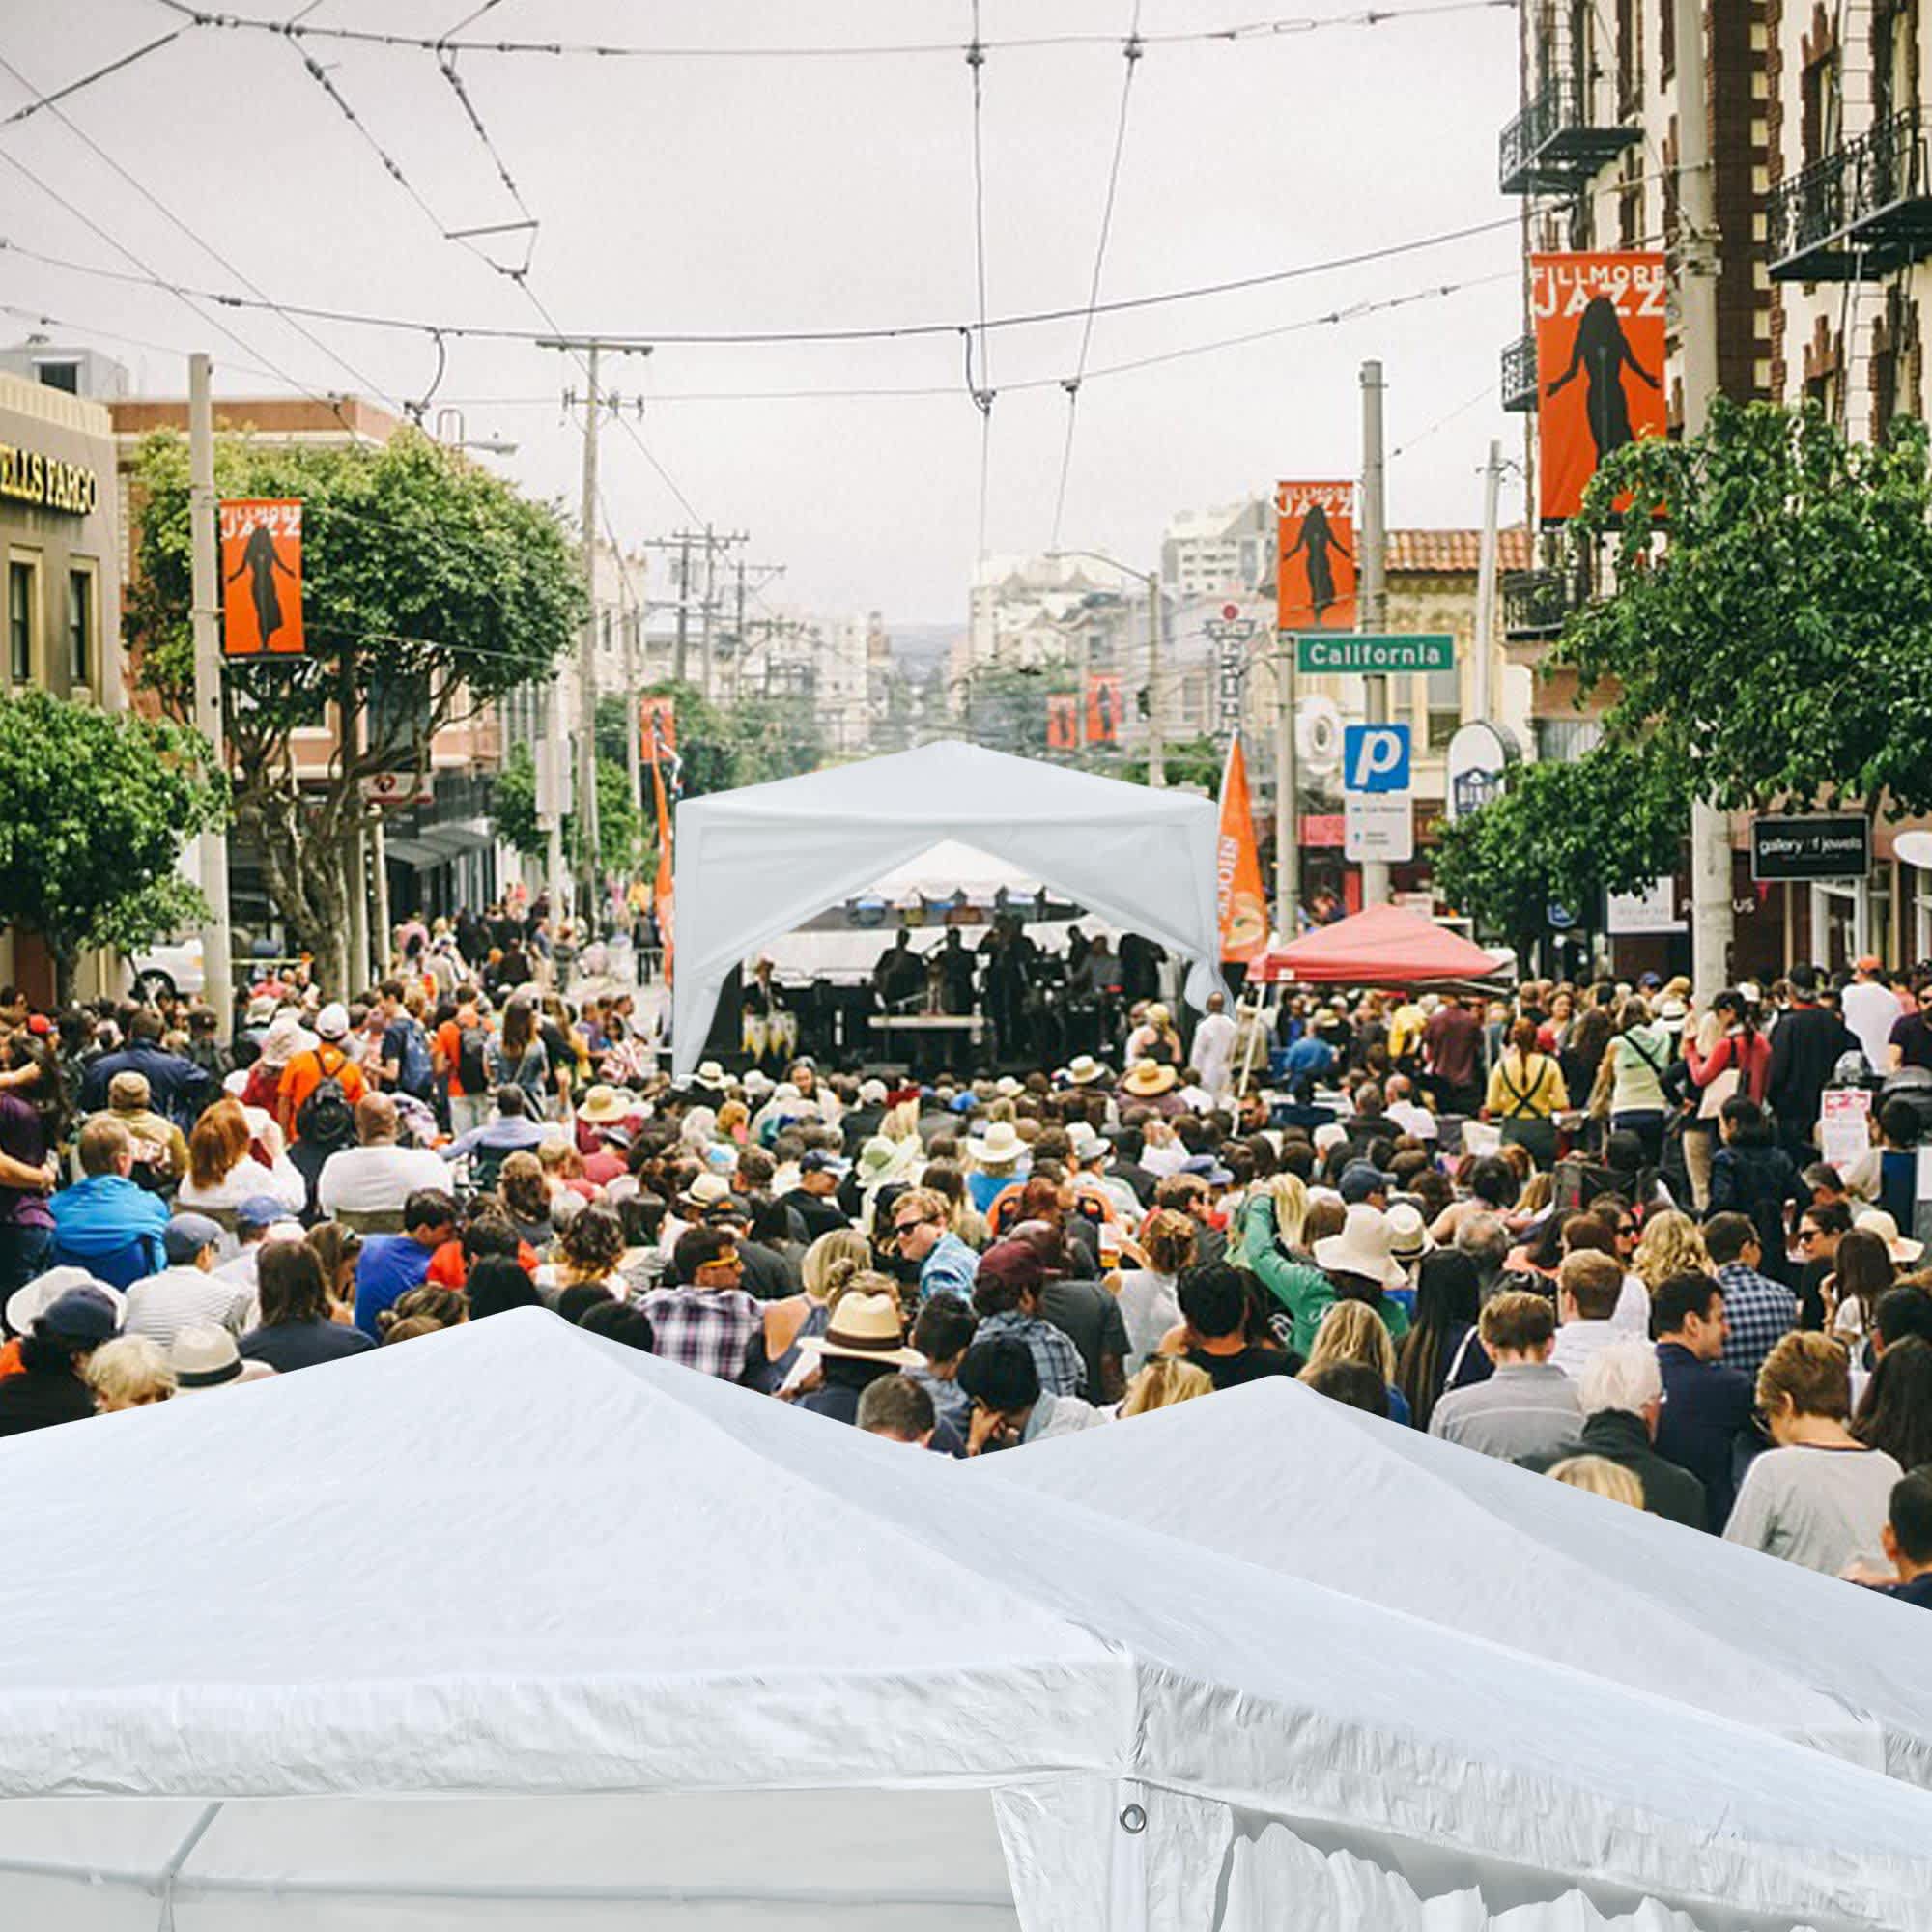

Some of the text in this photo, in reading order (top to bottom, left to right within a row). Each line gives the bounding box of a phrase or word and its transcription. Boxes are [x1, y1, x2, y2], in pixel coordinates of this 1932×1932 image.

[1530, 265, 1665, 285] FILLMORE
[1530, 282, 1666, 317] JAZZ
[0, 441, 99, 514] ELLS FARGO
[221, 515, 302, 538] JAZZ
[1310, 643, 1441, 664] California
[1759, 838, 1803, 855] gallery
[1820, 837, 1863, 854] jewels
